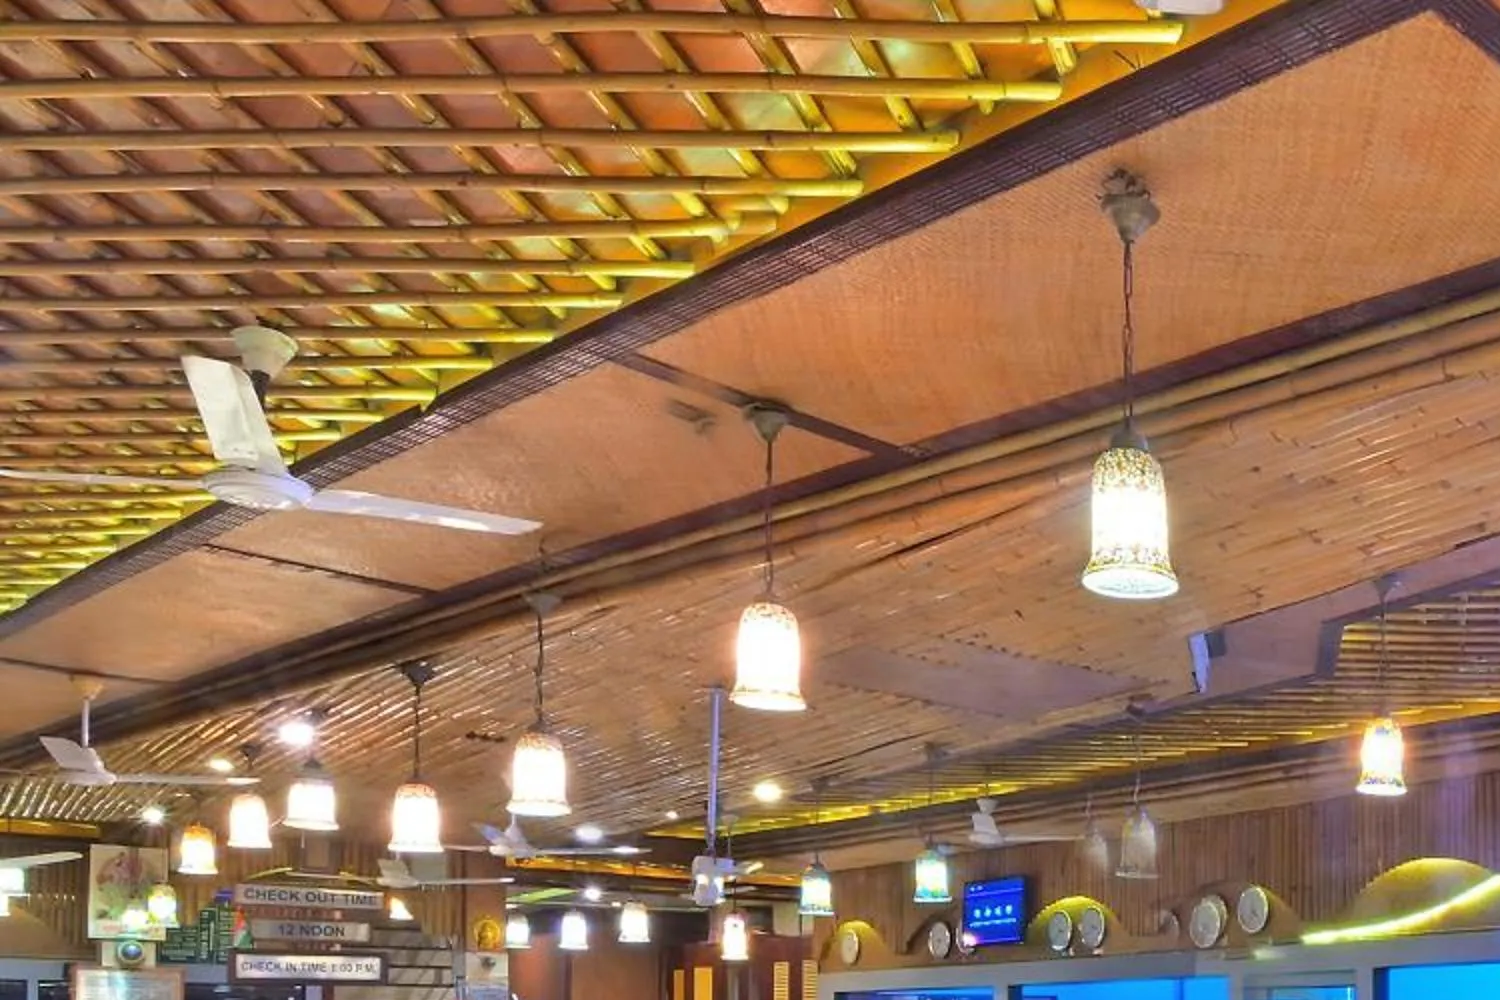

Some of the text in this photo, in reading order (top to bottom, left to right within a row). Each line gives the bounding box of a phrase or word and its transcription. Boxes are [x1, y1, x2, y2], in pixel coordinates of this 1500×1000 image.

[243, 888, 378, 906] CHECK OUT TIME
[278, 922, 345, 938] 12 NOON
[241, 960, 281, 972] CHECK
[285, 961, 297, 973] IN
[300, 962, 327, 973] TIME
